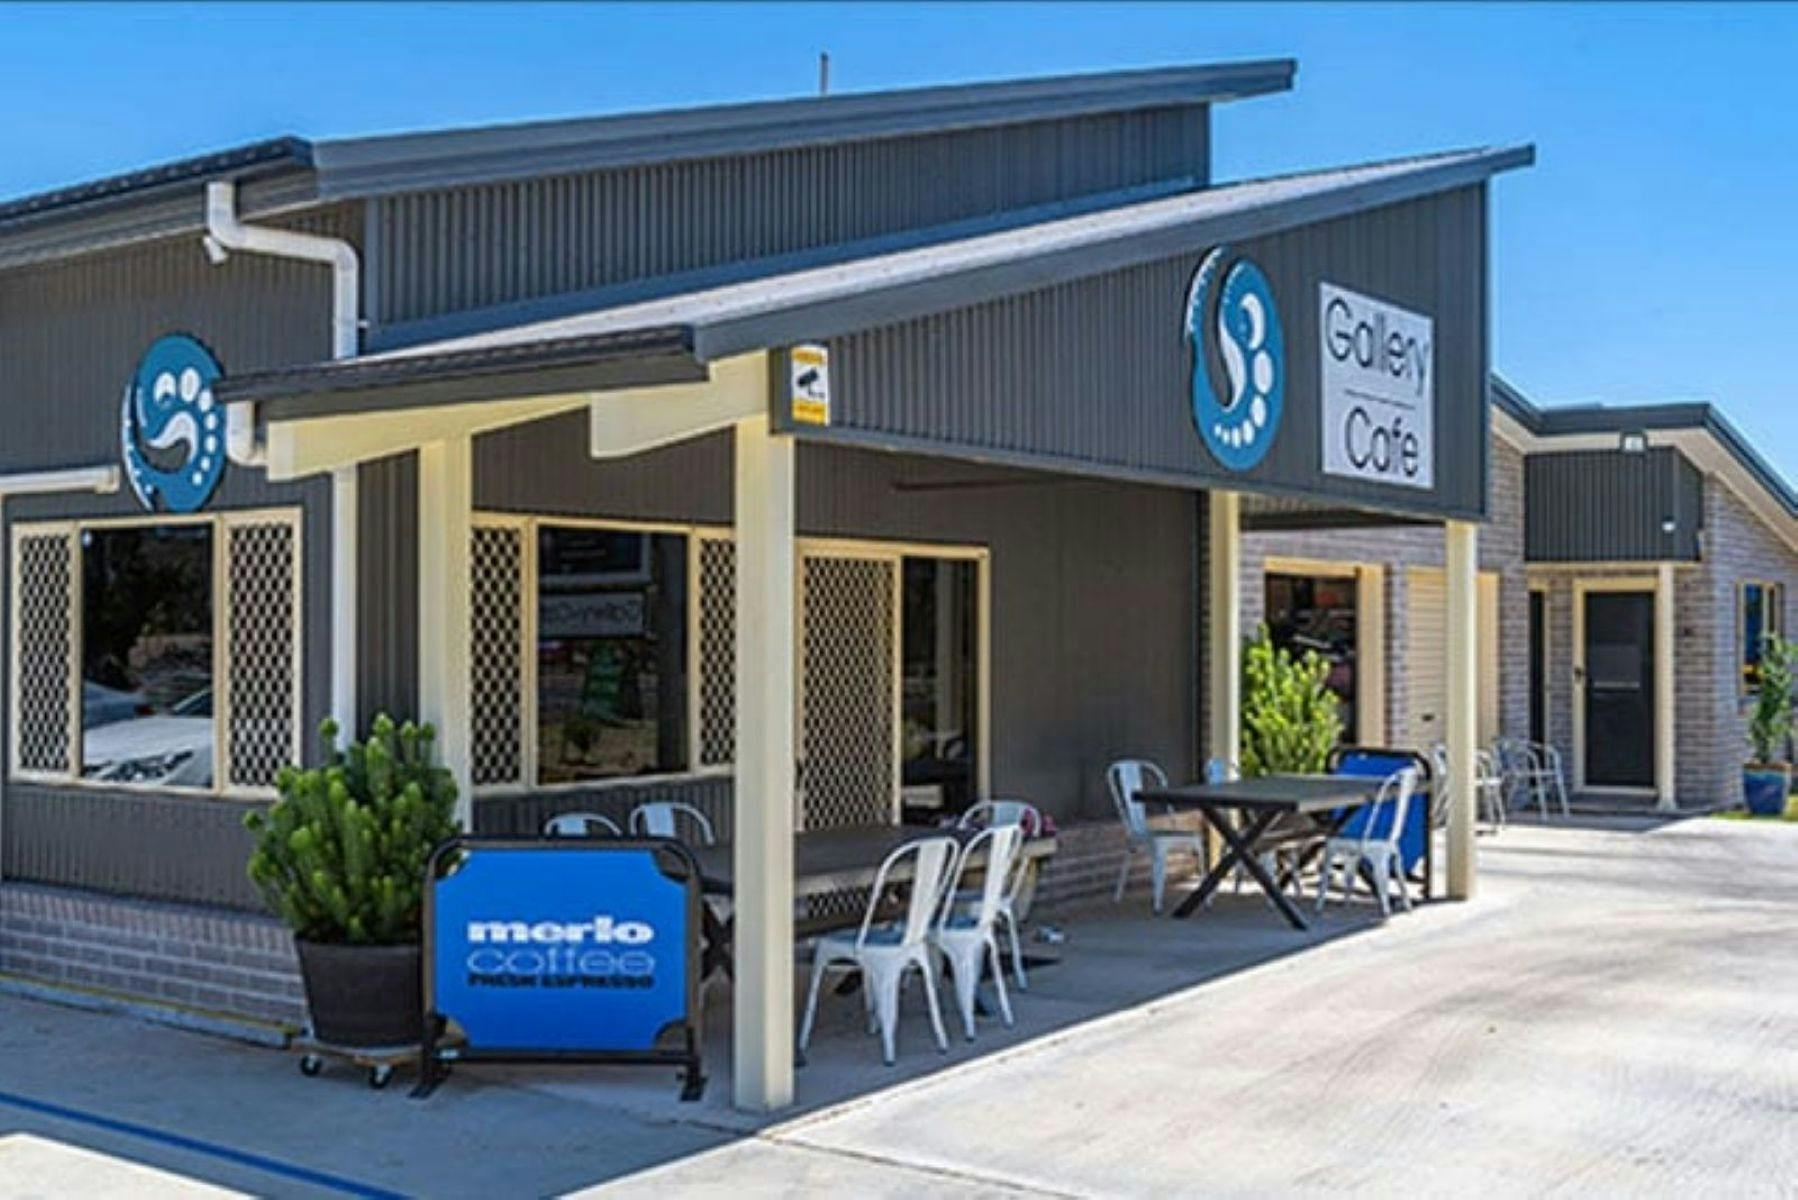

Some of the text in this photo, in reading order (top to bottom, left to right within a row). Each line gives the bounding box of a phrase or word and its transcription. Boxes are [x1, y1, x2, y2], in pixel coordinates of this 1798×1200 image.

[1326, 297, 1428, 396] Gallery
[468, 914, 653, 943] merlo
[467, 945, 655, 975] coffee
